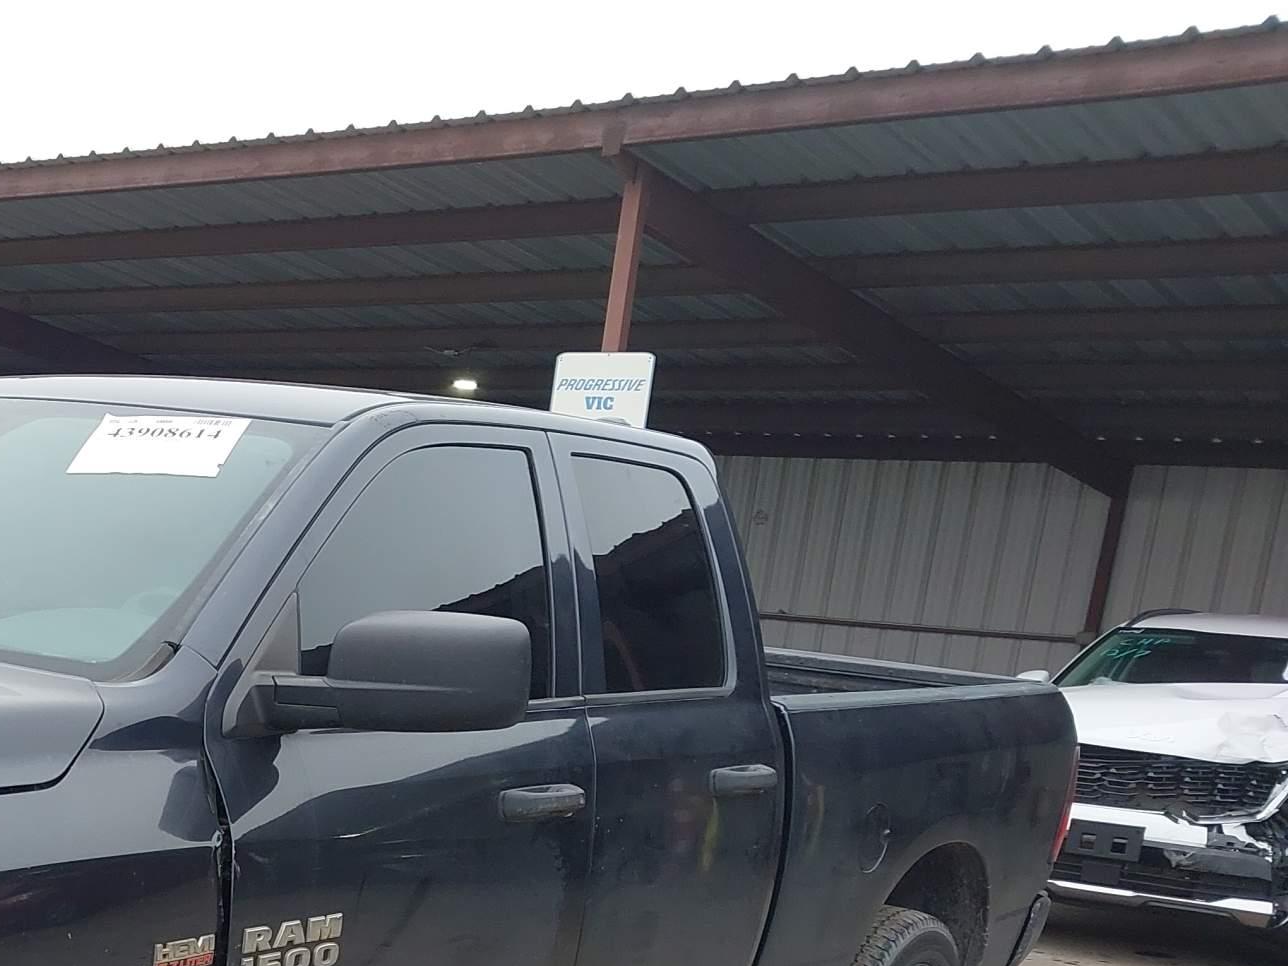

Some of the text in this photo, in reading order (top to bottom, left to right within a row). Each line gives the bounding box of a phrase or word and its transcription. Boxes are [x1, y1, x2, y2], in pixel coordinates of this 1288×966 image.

[557, 378, 646, 392] PROGRESSIVE
[585, 396, 615, 410] VIC
[107, 427, 222, 440] 43908614
[241, 913, 343, 954] RAM
